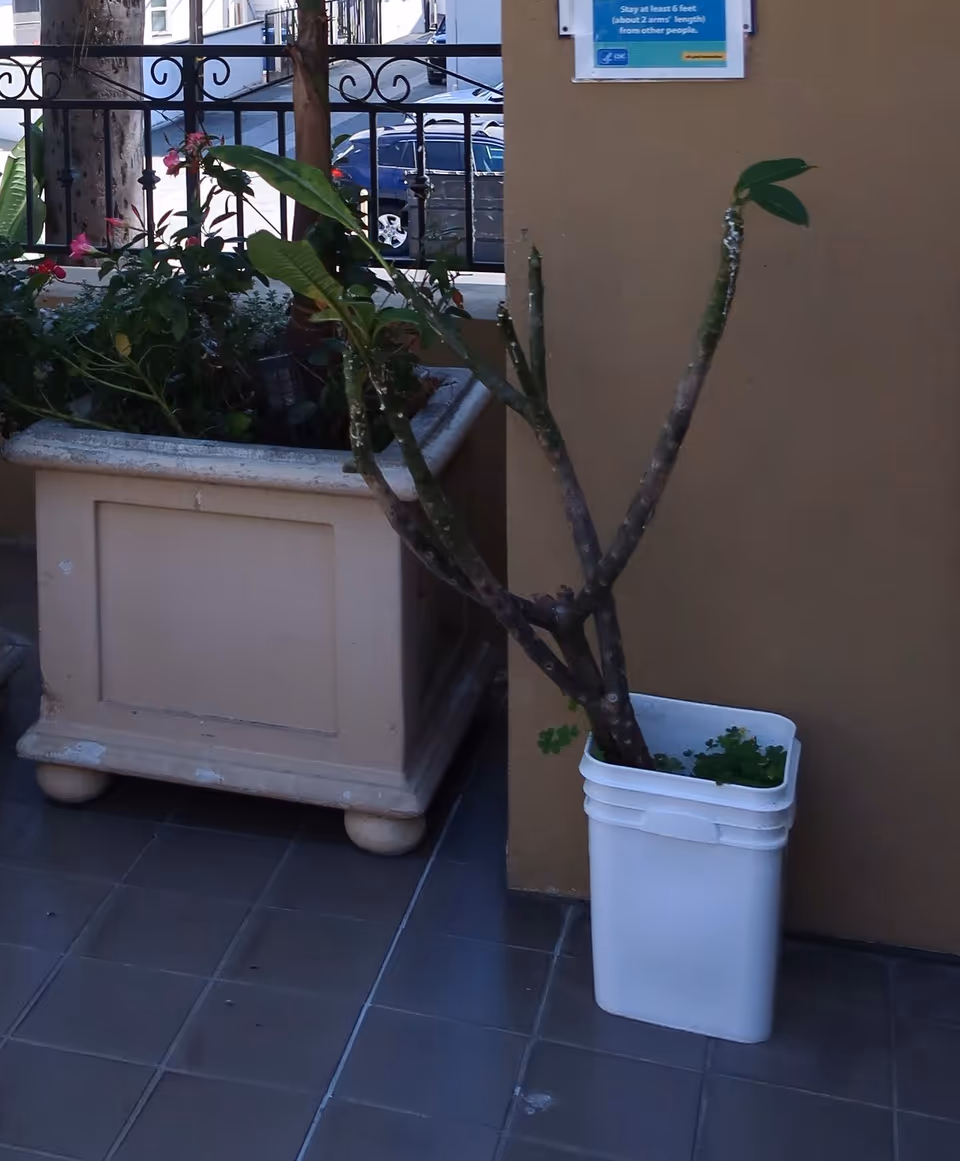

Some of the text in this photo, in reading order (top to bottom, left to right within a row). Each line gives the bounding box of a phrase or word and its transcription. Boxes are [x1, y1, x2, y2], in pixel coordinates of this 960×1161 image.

[620, 5, 639, 14] Stay
[679, 4, 697, 12] feet
[612, 16, 640, 25] (about
[674, 15, 706, 24] length)
[619, 26, 699, 35] from other people.
